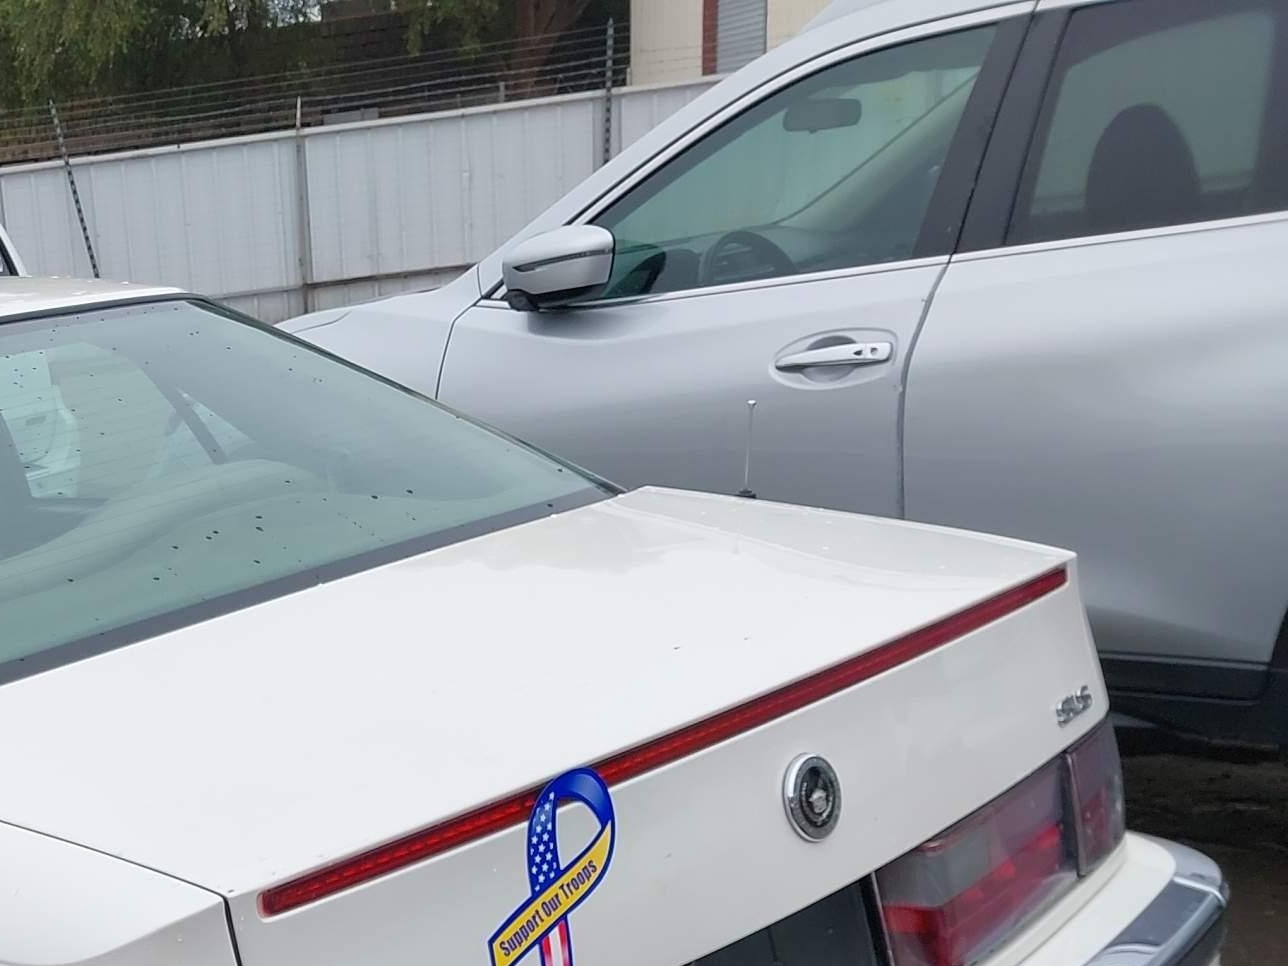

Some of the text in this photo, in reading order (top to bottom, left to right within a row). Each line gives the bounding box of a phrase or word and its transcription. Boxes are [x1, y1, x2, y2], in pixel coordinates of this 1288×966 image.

[499, 860, 597, 957] Support Our Troops
